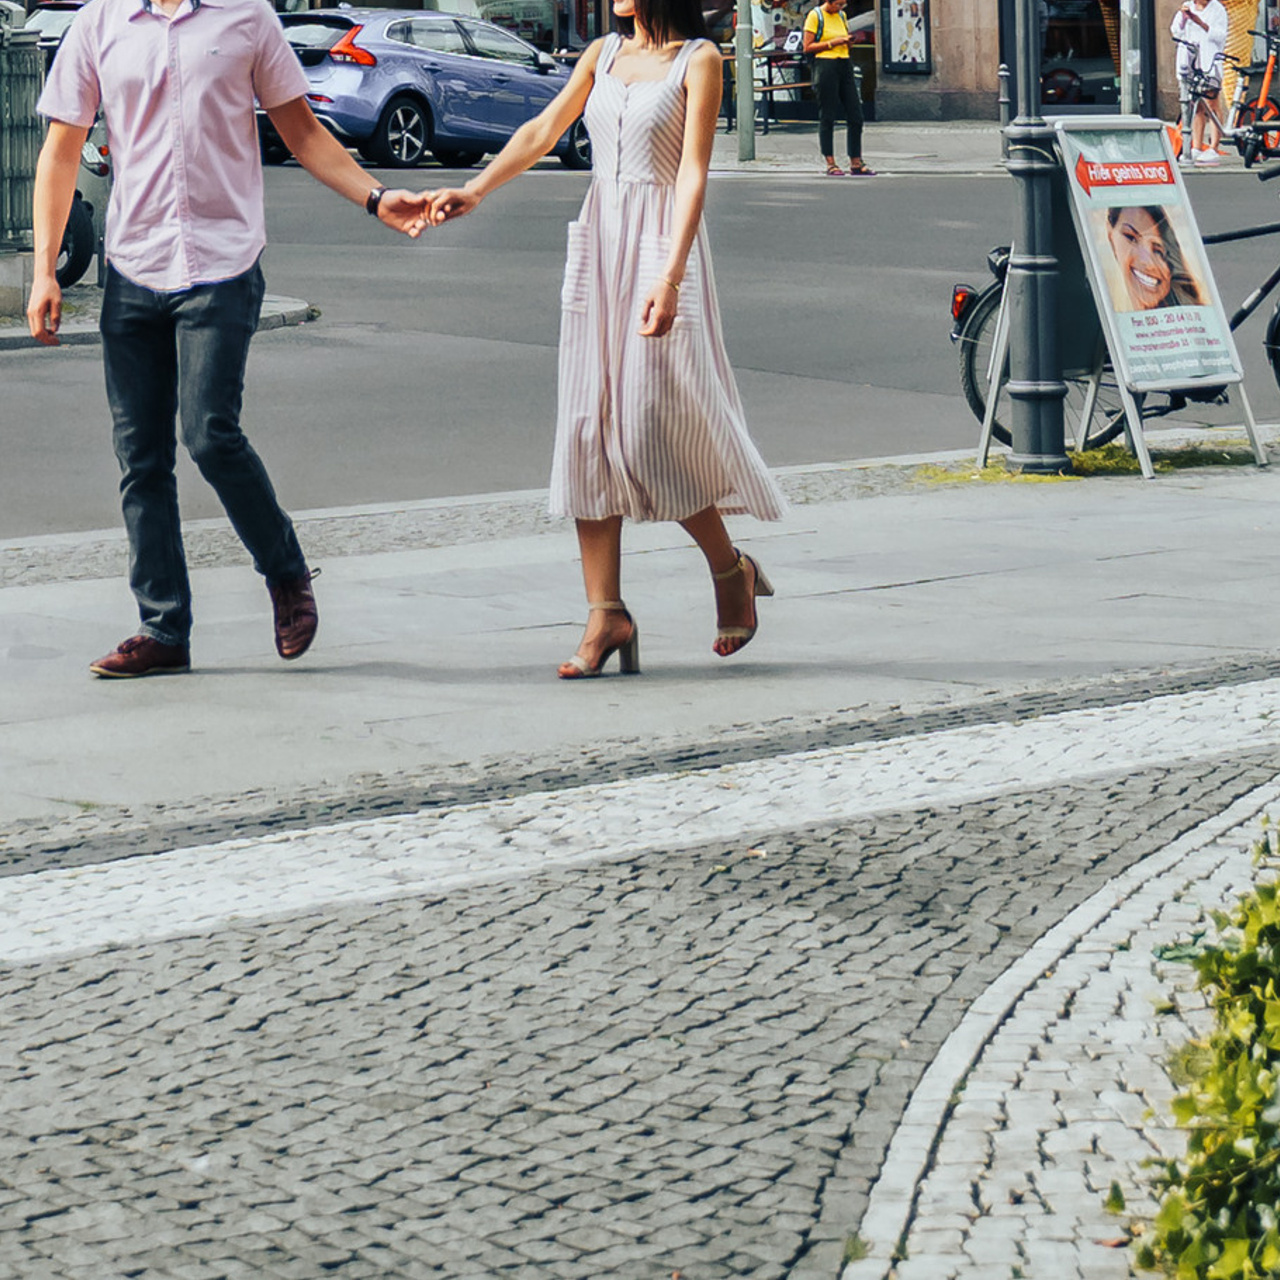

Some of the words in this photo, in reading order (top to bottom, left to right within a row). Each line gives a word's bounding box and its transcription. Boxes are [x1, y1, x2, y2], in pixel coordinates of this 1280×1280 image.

[1088, 163, 1112, 181] Hier
[1111, 164, 1144, 183] gehts
[1138, 163, 1169, 182] lang
